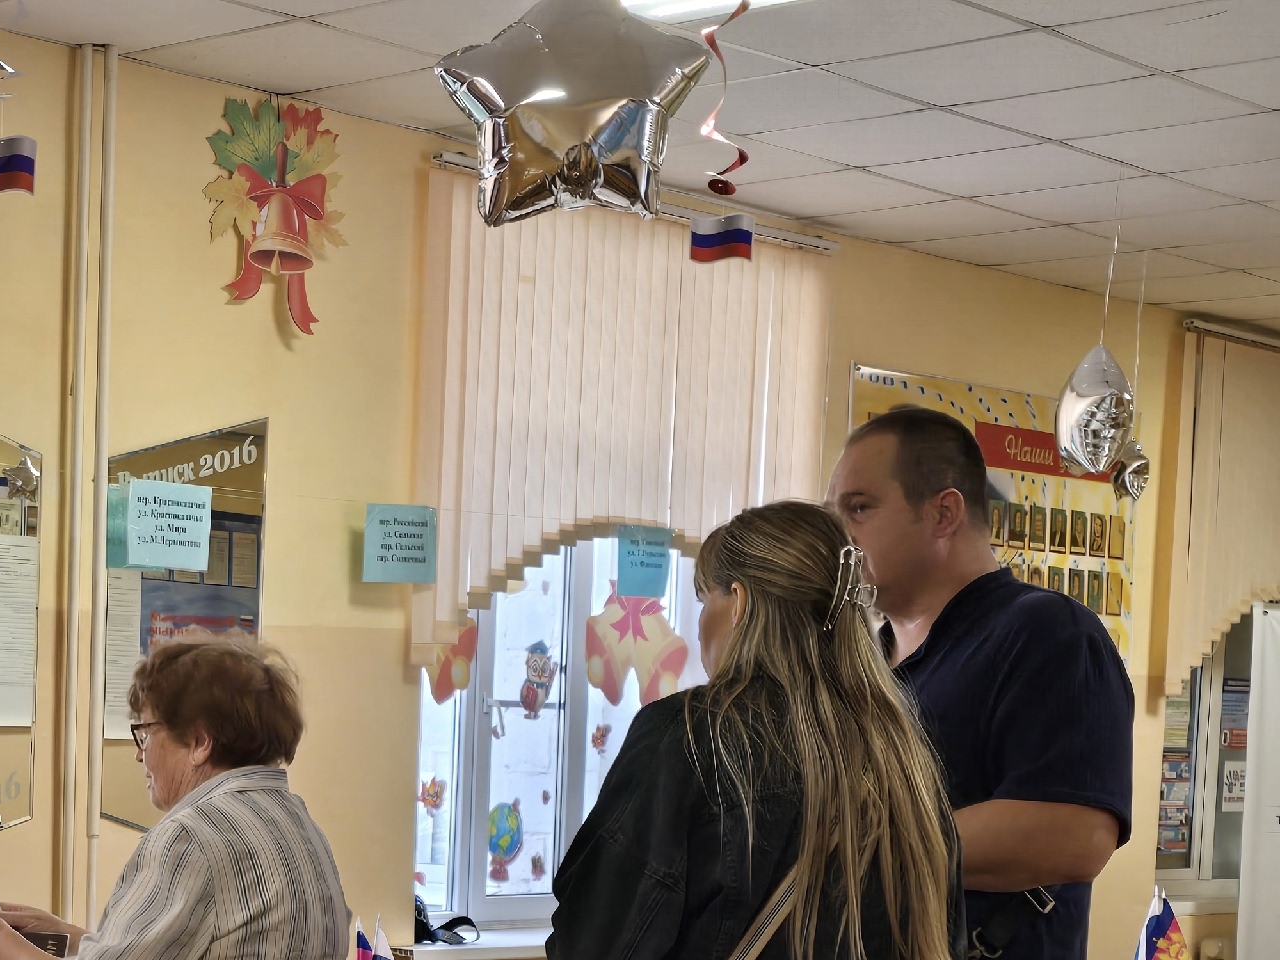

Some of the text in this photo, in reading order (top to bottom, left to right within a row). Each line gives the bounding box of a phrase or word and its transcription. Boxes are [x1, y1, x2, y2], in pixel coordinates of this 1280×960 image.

[199, 435, 258, 478] 2016
[1005, 435, 1053, 465] Наши
[167, 523, 187, 535] Мира
